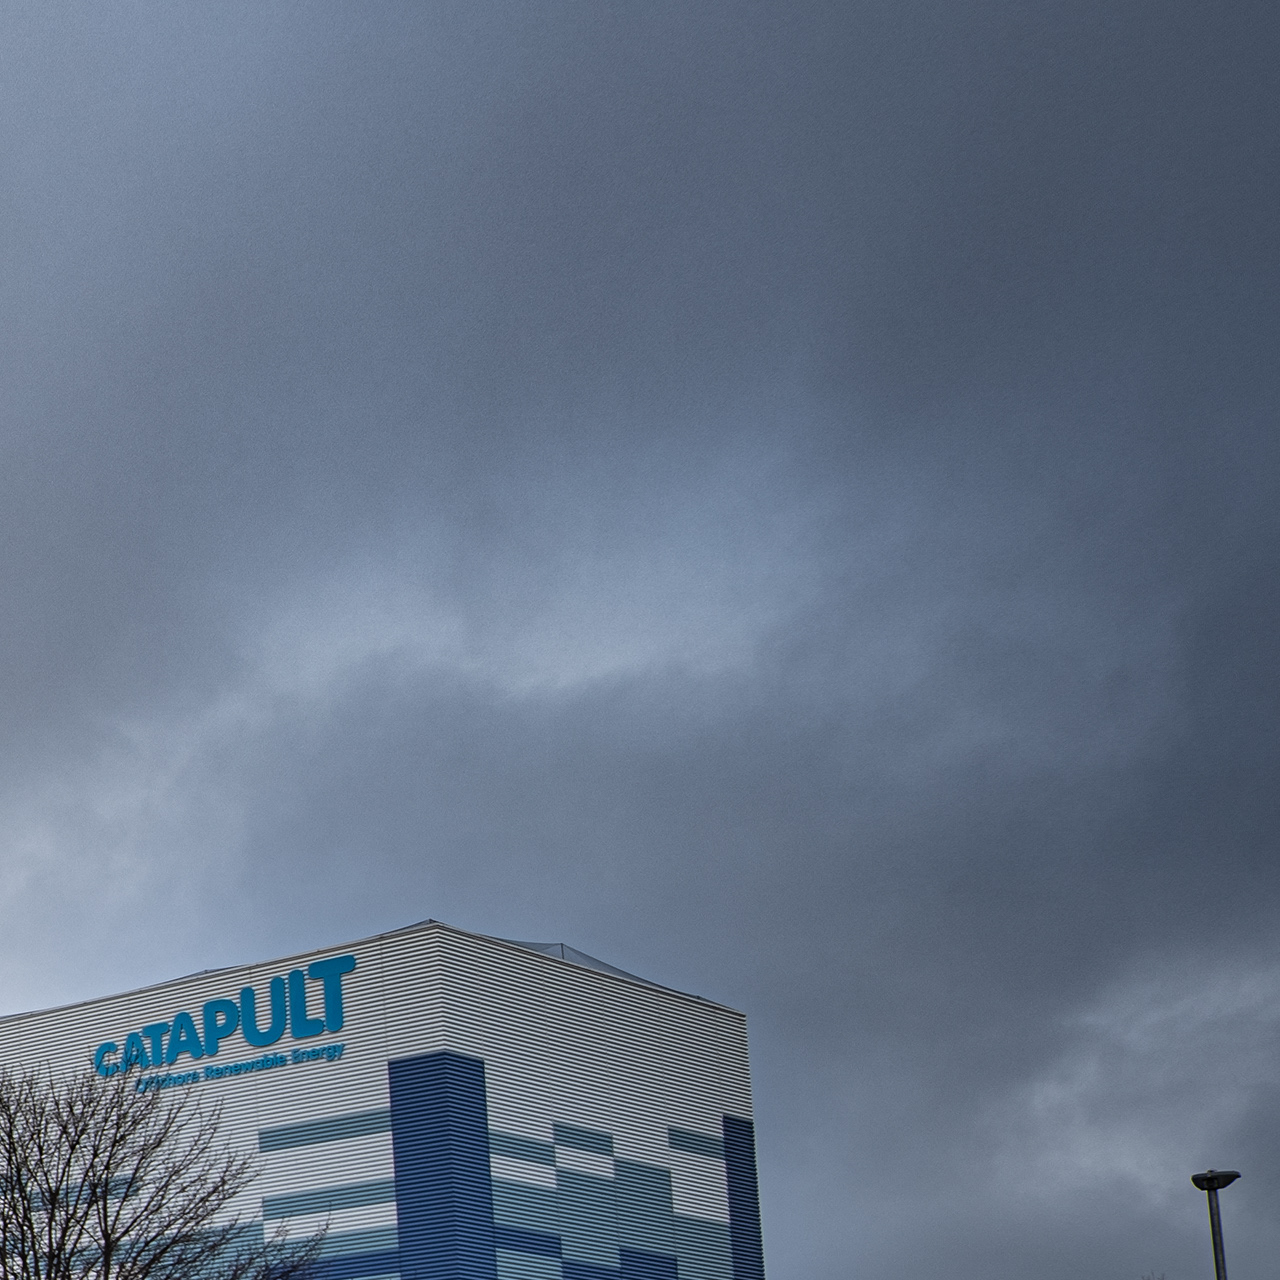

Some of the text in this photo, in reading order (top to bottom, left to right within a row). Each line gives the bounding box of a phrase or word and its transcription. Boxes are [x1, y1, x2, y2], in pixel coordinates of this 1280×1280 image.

[93, 954, 357, 1077] CATAPULT
[135, 1043, 345, 1093] Offshore Renewable Energy
